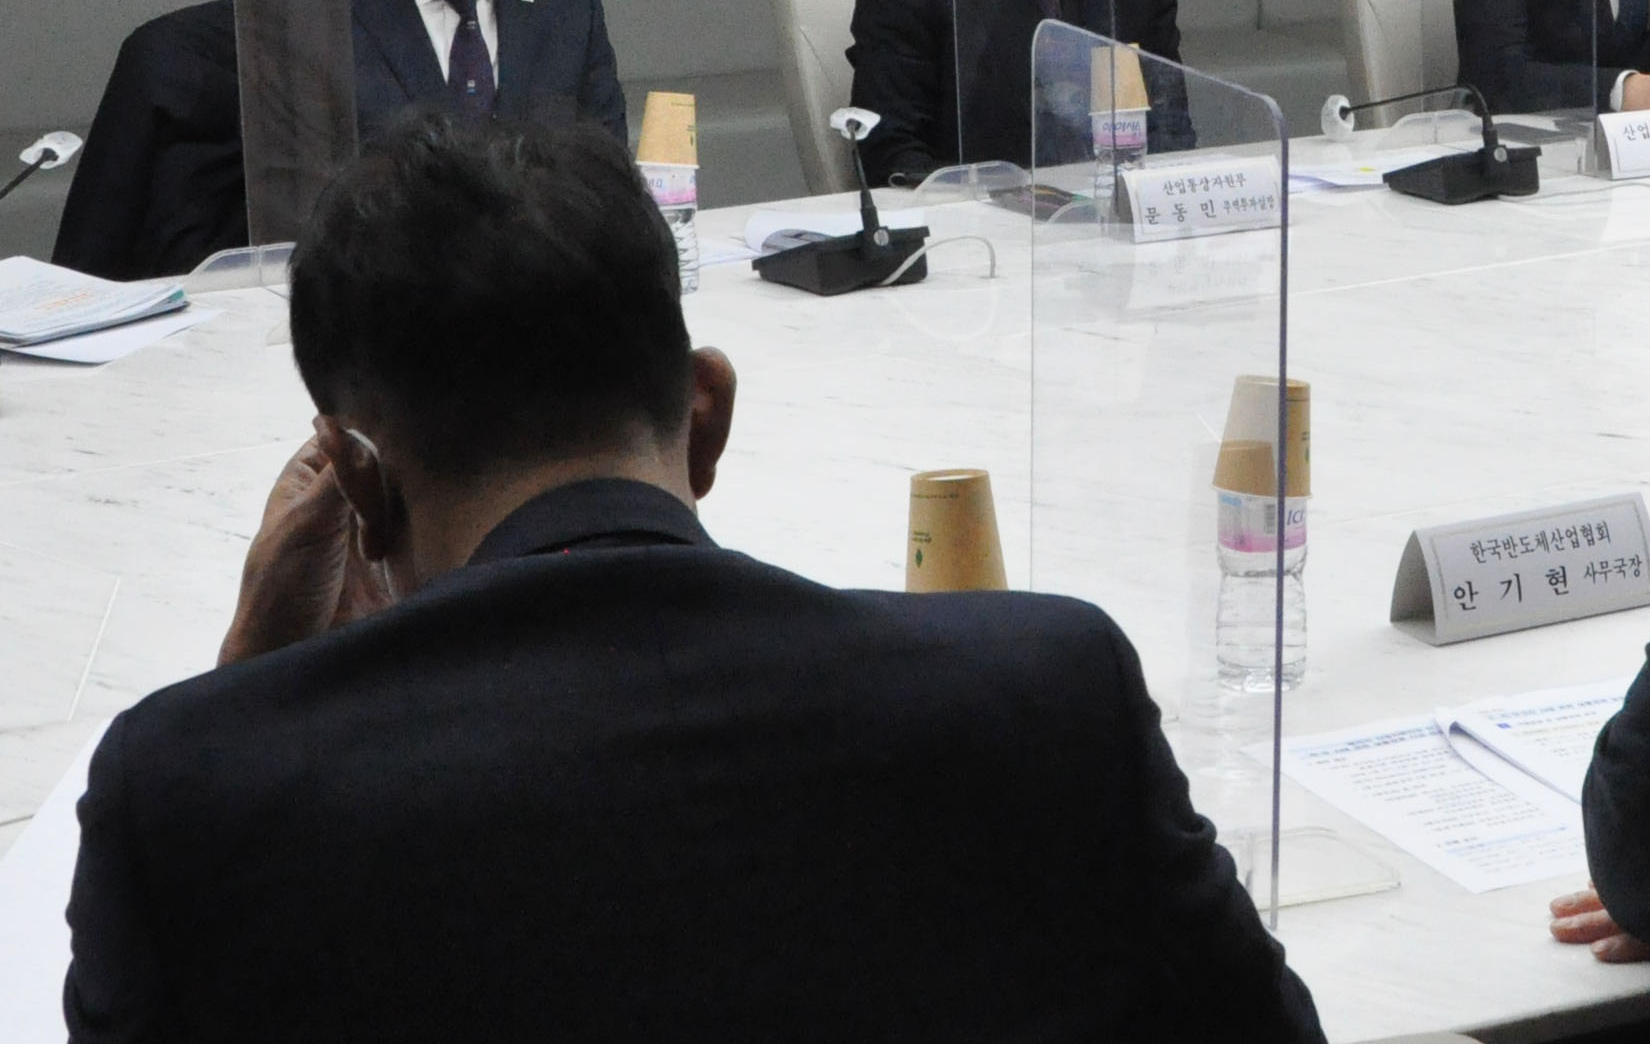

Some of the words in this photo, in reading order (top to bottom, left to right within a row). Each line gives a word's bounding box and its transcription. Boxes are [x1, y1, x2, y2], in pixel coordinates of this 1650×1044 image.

[1162, 172, 1247, 196] 산업통상자원부
[1469, 519, 1612, 565] 한국반도체산업협회
[1582, 554, 1643, 586] 사무국장
